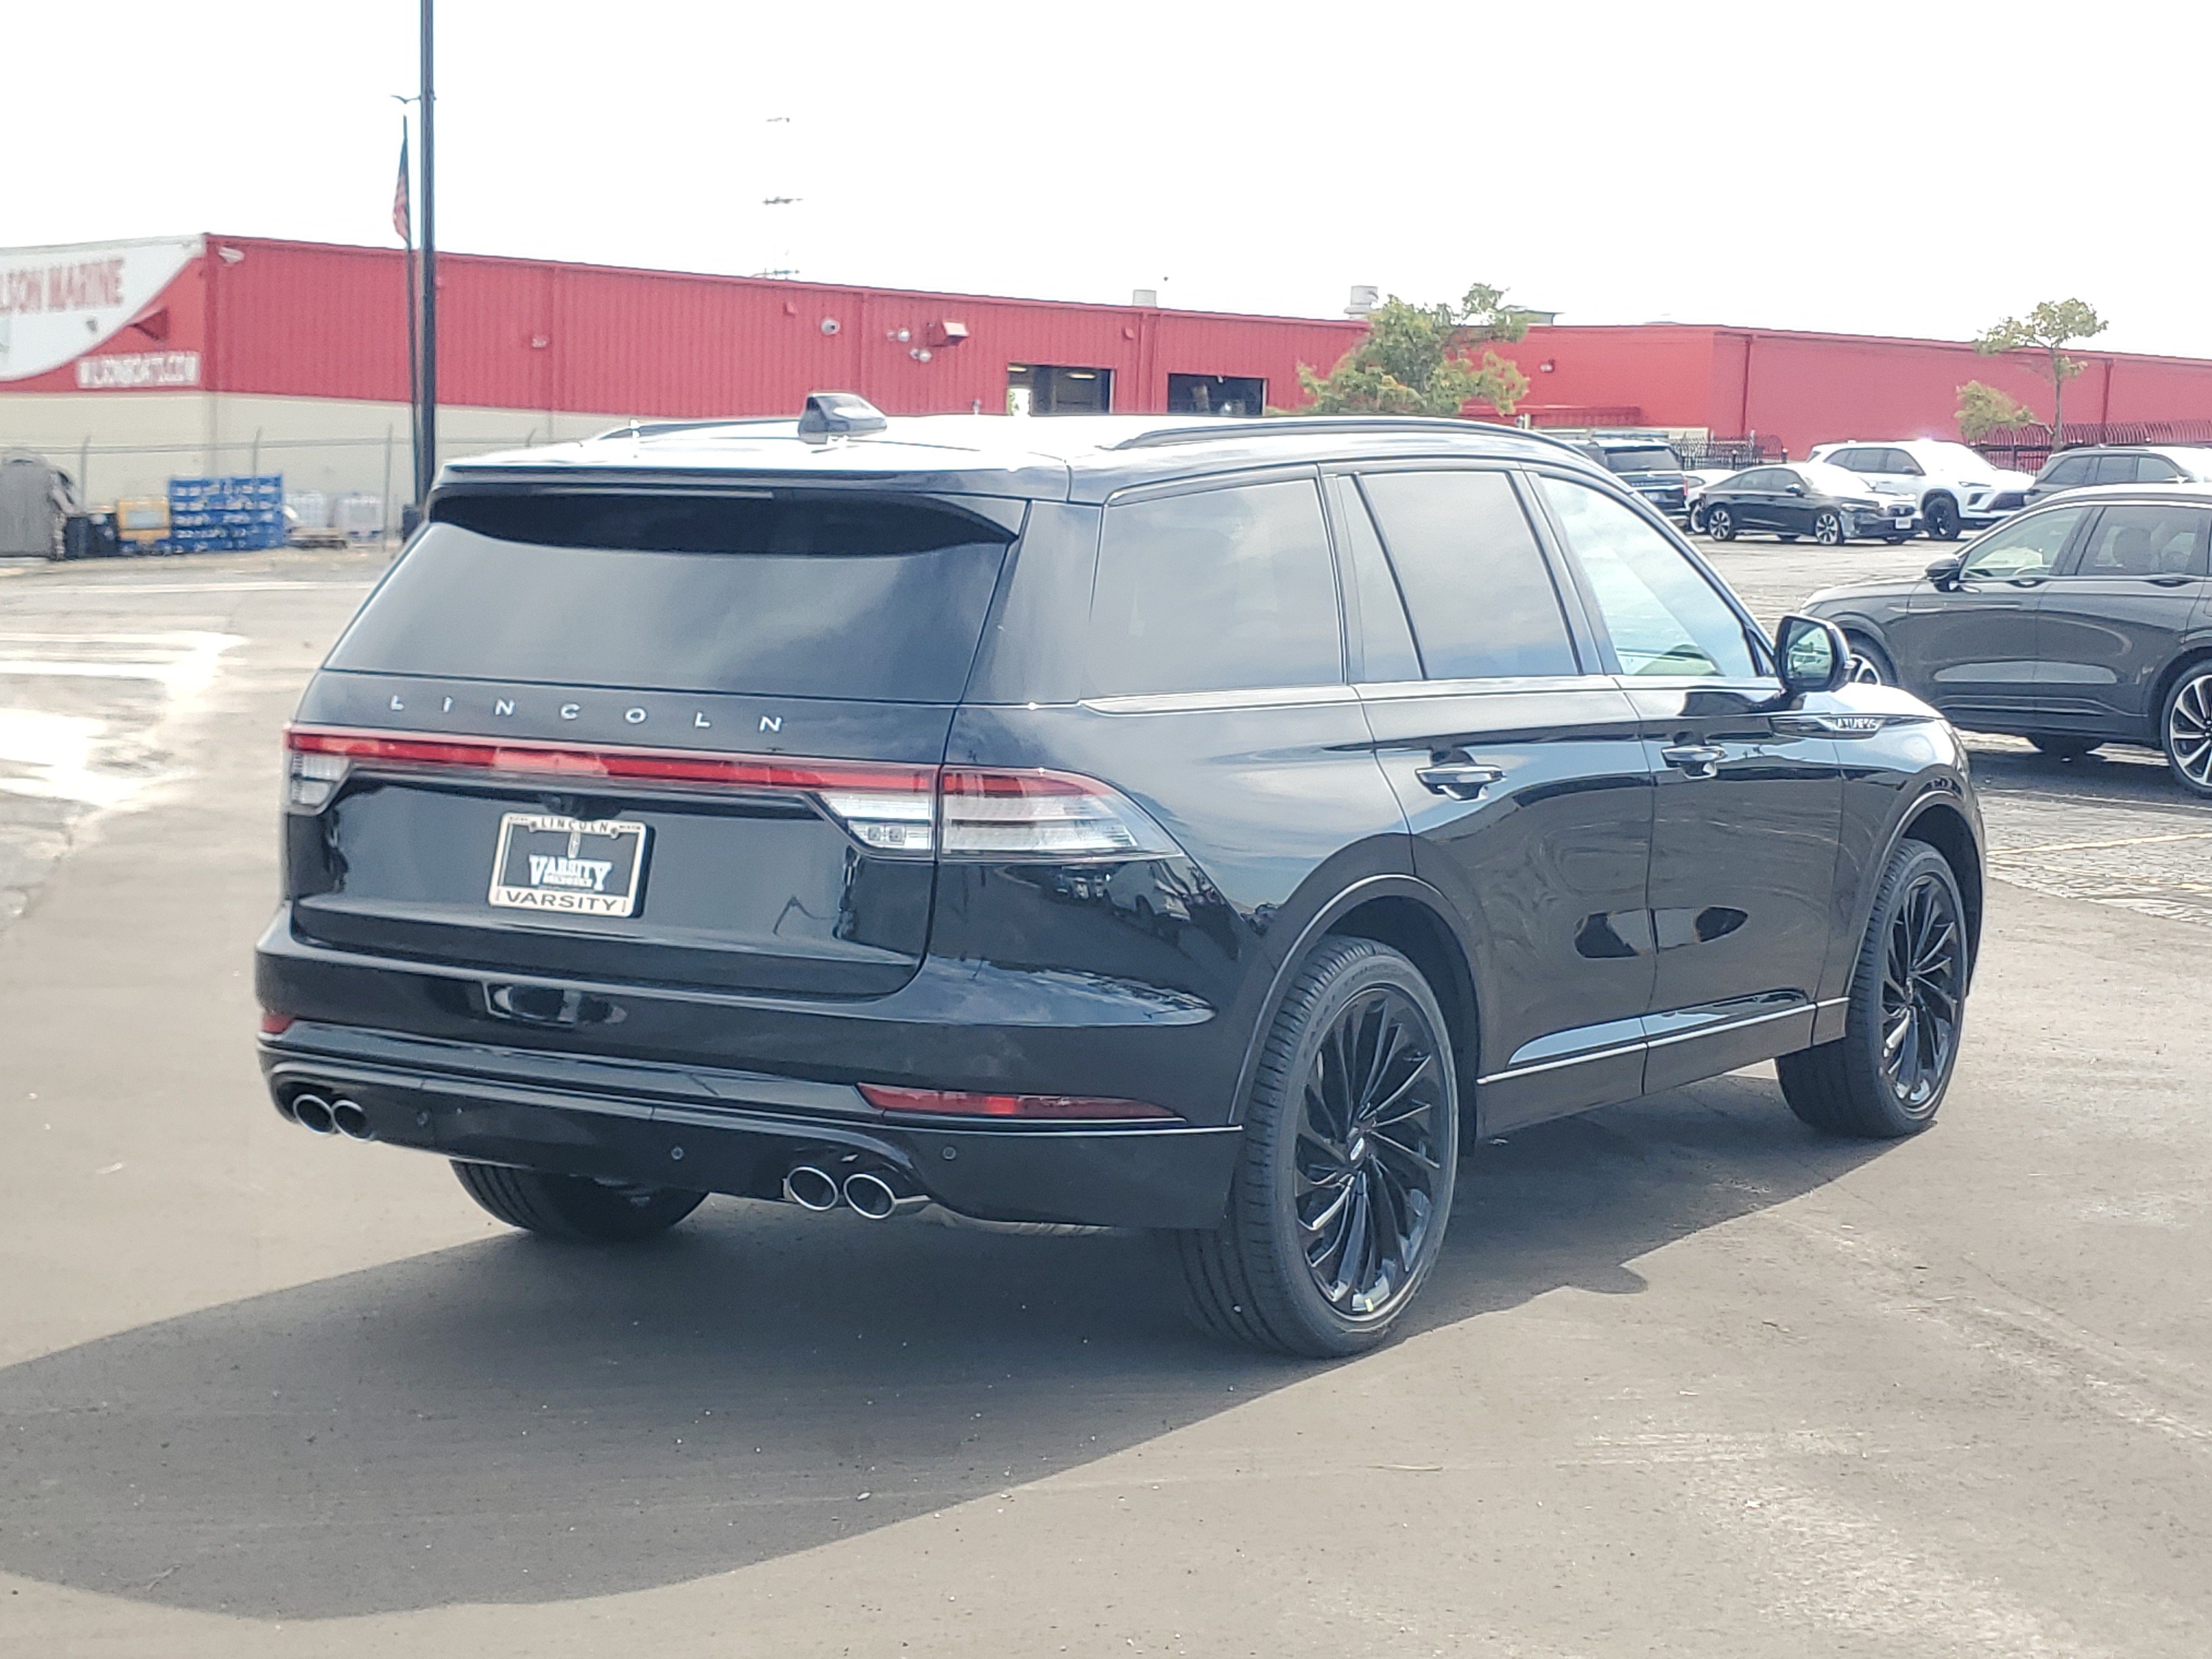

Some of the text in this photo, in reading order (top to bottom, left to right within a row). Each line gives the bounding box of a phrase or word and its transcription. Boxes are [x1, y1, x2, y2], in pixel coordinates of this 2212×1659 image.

[389, 694, 783, 733] LINCOLN
[541, 817, 608, 833] LINCOLN
[505, 890, 618, 912] VARSITY
